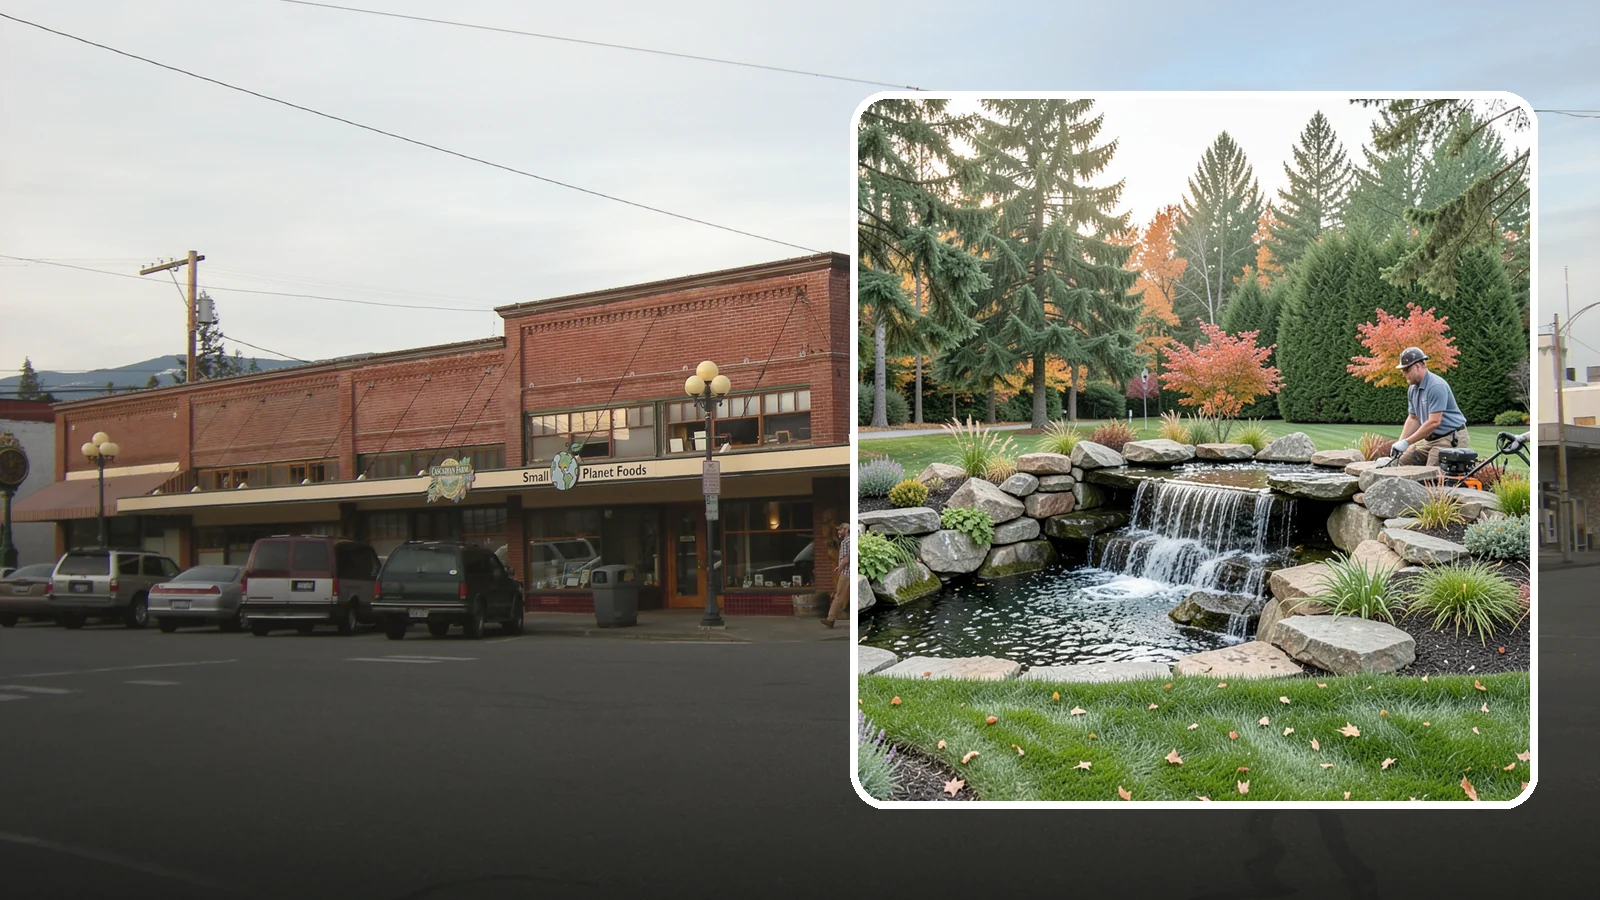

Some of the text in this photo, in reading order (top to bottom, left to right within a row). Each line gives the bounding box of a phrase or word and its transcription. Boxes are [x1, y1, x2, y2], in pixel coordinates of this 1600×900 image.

[523, 464, 647, 483] Small Planet Foods
